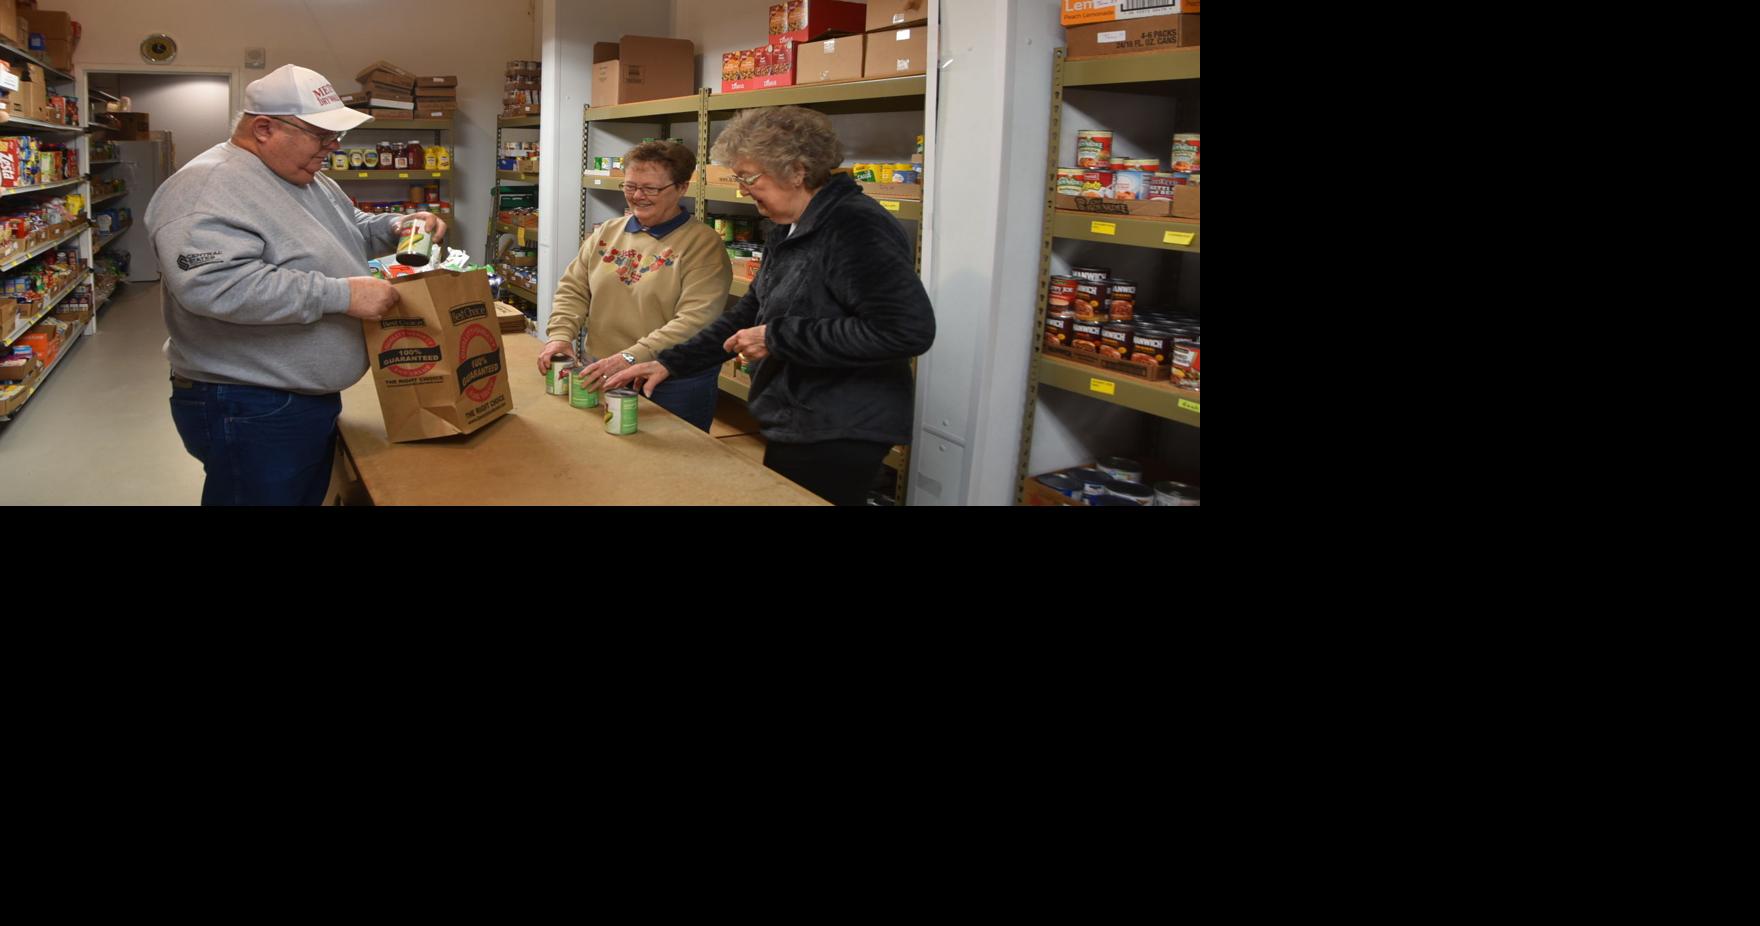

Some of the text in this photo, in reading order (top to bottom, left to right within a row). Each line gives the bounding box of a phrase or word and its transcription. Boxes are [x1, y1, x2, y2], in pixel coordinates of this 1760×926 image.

[1153, 29, 1177, 37] PACKS
[383, 354, 439, 365] GUARANTEED
[462, 362, 499, 386] GUARANTEED
[475, 402, 490, 414] RIGHT
